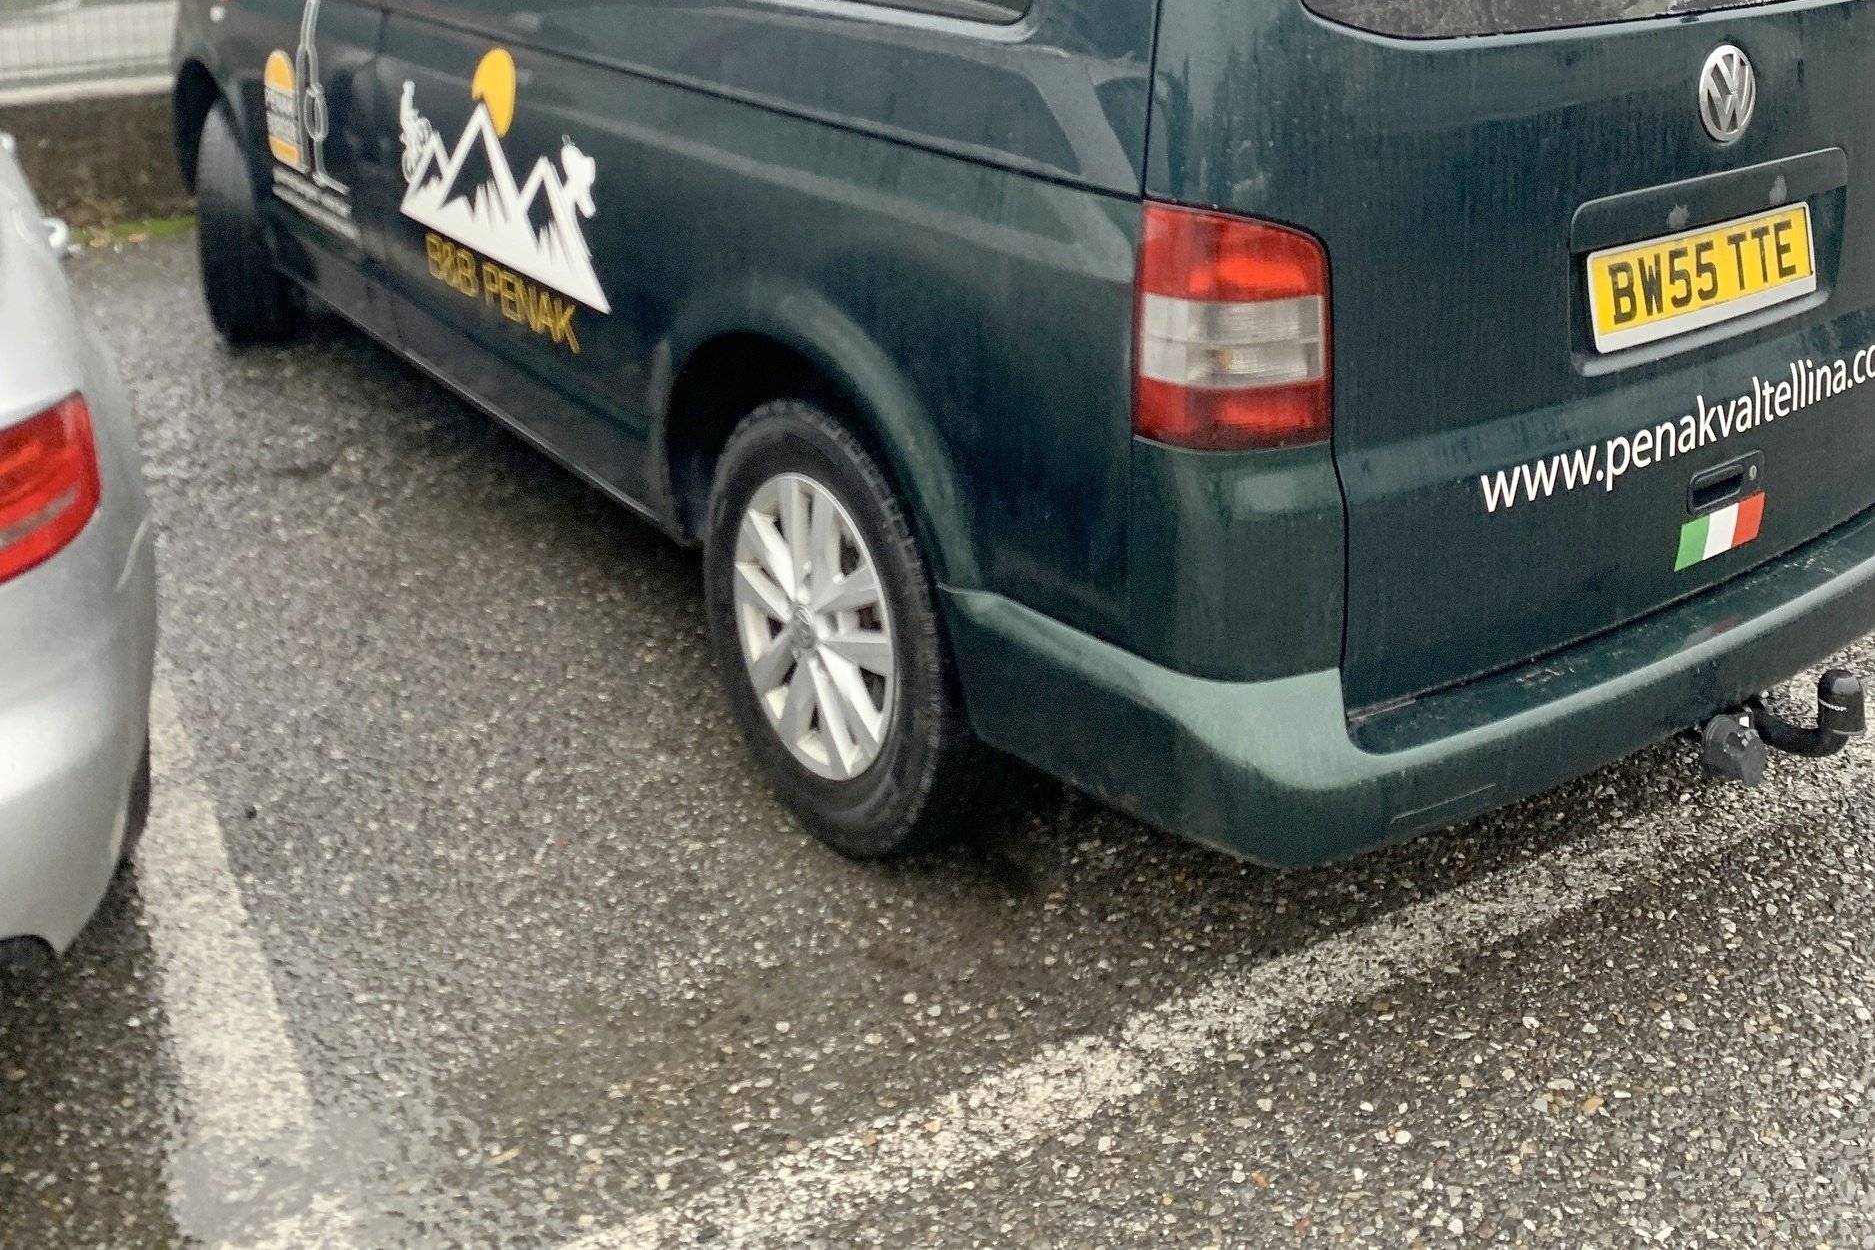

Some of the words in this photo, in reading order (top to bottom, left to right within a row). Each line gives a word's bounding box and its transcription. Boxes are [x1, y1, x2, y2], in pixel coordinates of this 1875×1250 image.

[482, 261, 580, 354] PENAK
[1607, 241, 1719, 325] BW55
[1727, 219, 1797, 290] TTE
